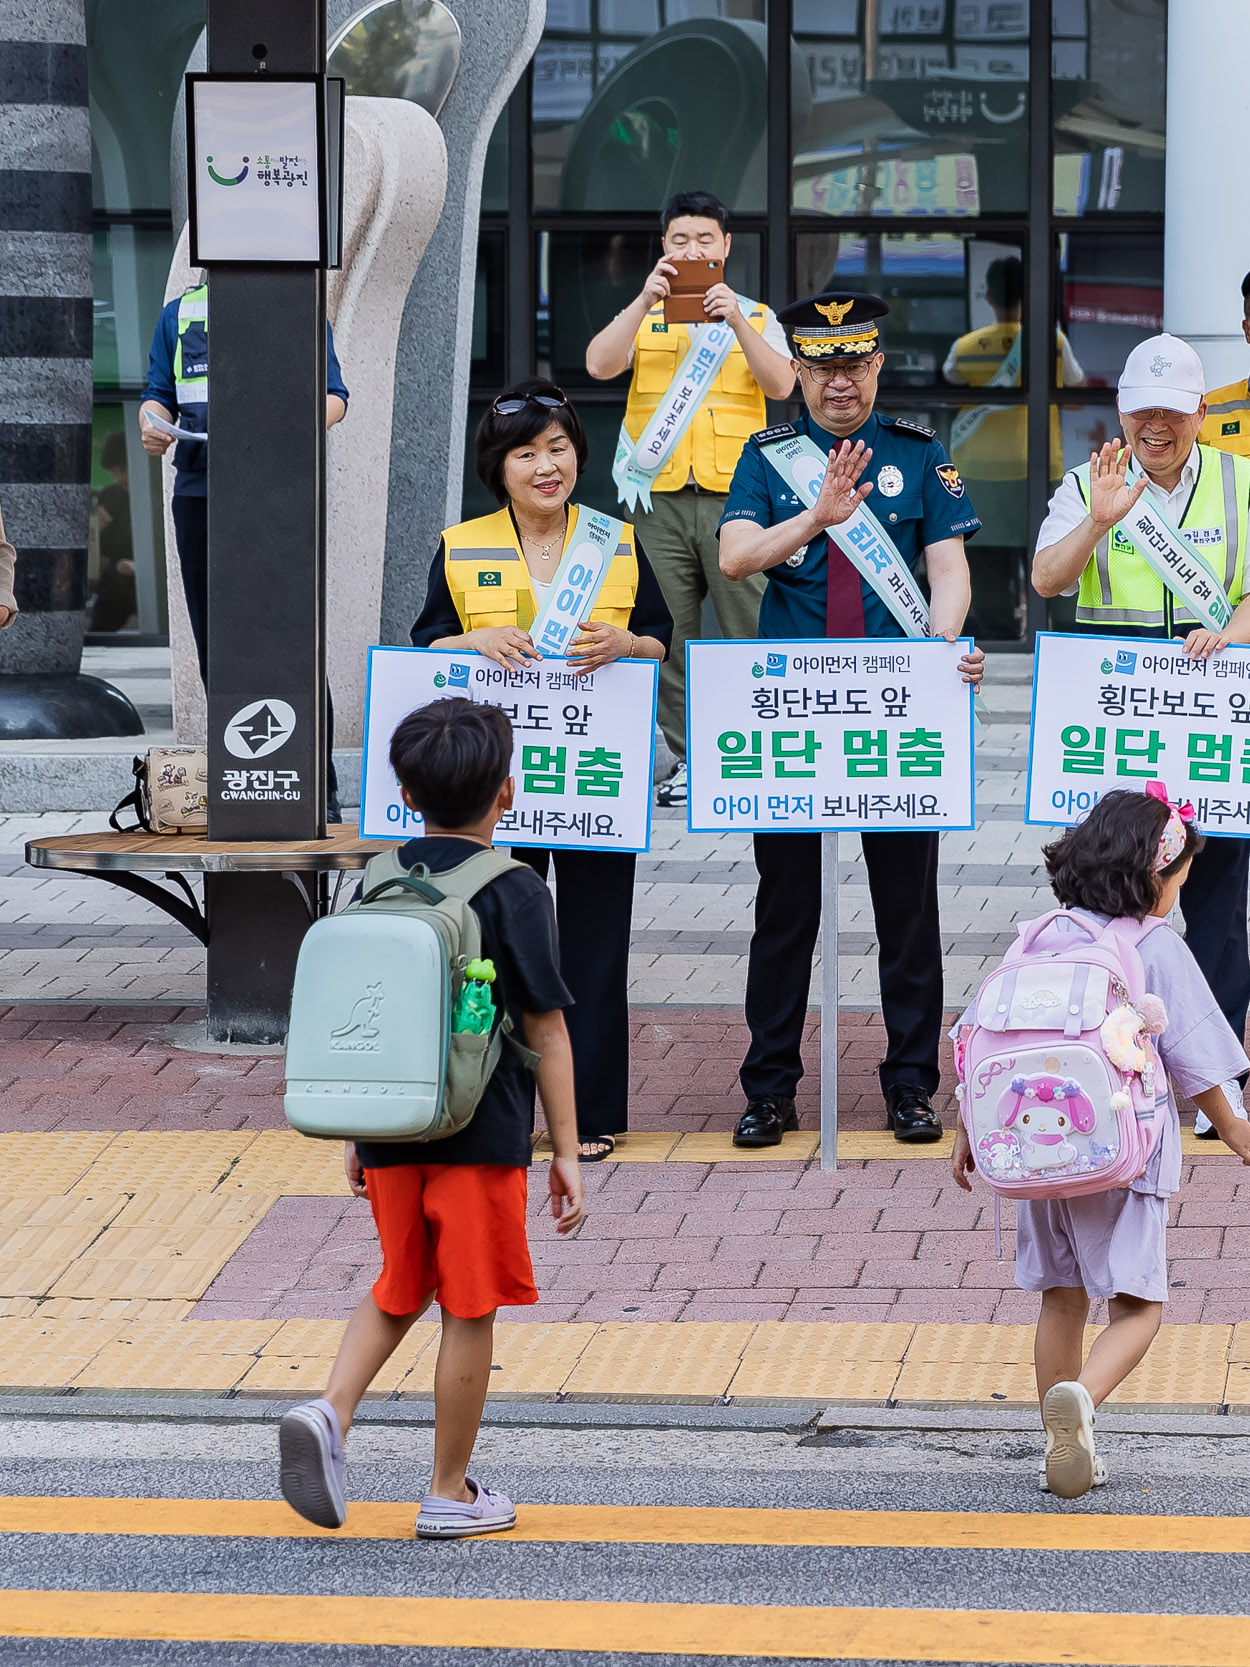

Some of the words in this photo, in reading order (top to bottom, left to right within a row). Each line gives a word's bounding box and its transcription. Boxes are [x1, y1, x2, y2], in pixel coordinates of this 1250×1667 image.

[256, 169, 308, 187] 행복광진
[686, 347, 716, 386] 먼저
[846, 521, 892, 575] 먼저
[556, 563, 593, 617] 아이
[793, 655, 857, 675] 아이먼저
[862, 655, 911, 674] 캠페인
[1142, 655, 1208, 677] 아이먼저
[474, 668, 540, 689] 아이먼저
[545, 672, 595, 692] 캠페인
[751, 687, 872, 720] 횡단보도
[880, 686, 912, 718] 앞
[1097, 684, 1219, 719] 횡단보도
[562, 704, 593, 736] 앞
[717, 730, 822, 779] 일단
[843, 728, 945, 778] 멈춤
[1060, 725, 1166, 778] 일단
[222, 770, 301, 790] 광진구
[521, 744, 624, 798] 멈춤
[220, 790, 302, 801] GWANGJIN-GU
[712, 794, 760, 820] 아이
[767, 794, 814, 820] 먼저
[821, 793, 948, 820] 보내주세요.
[496, 809, 623, 838] 보내주세요.
[330, 1039, 381, 1051] KANGOL
[305, 1083, 405, 1095] KANGOL
[416, 1523, 438, 1531] crocs
